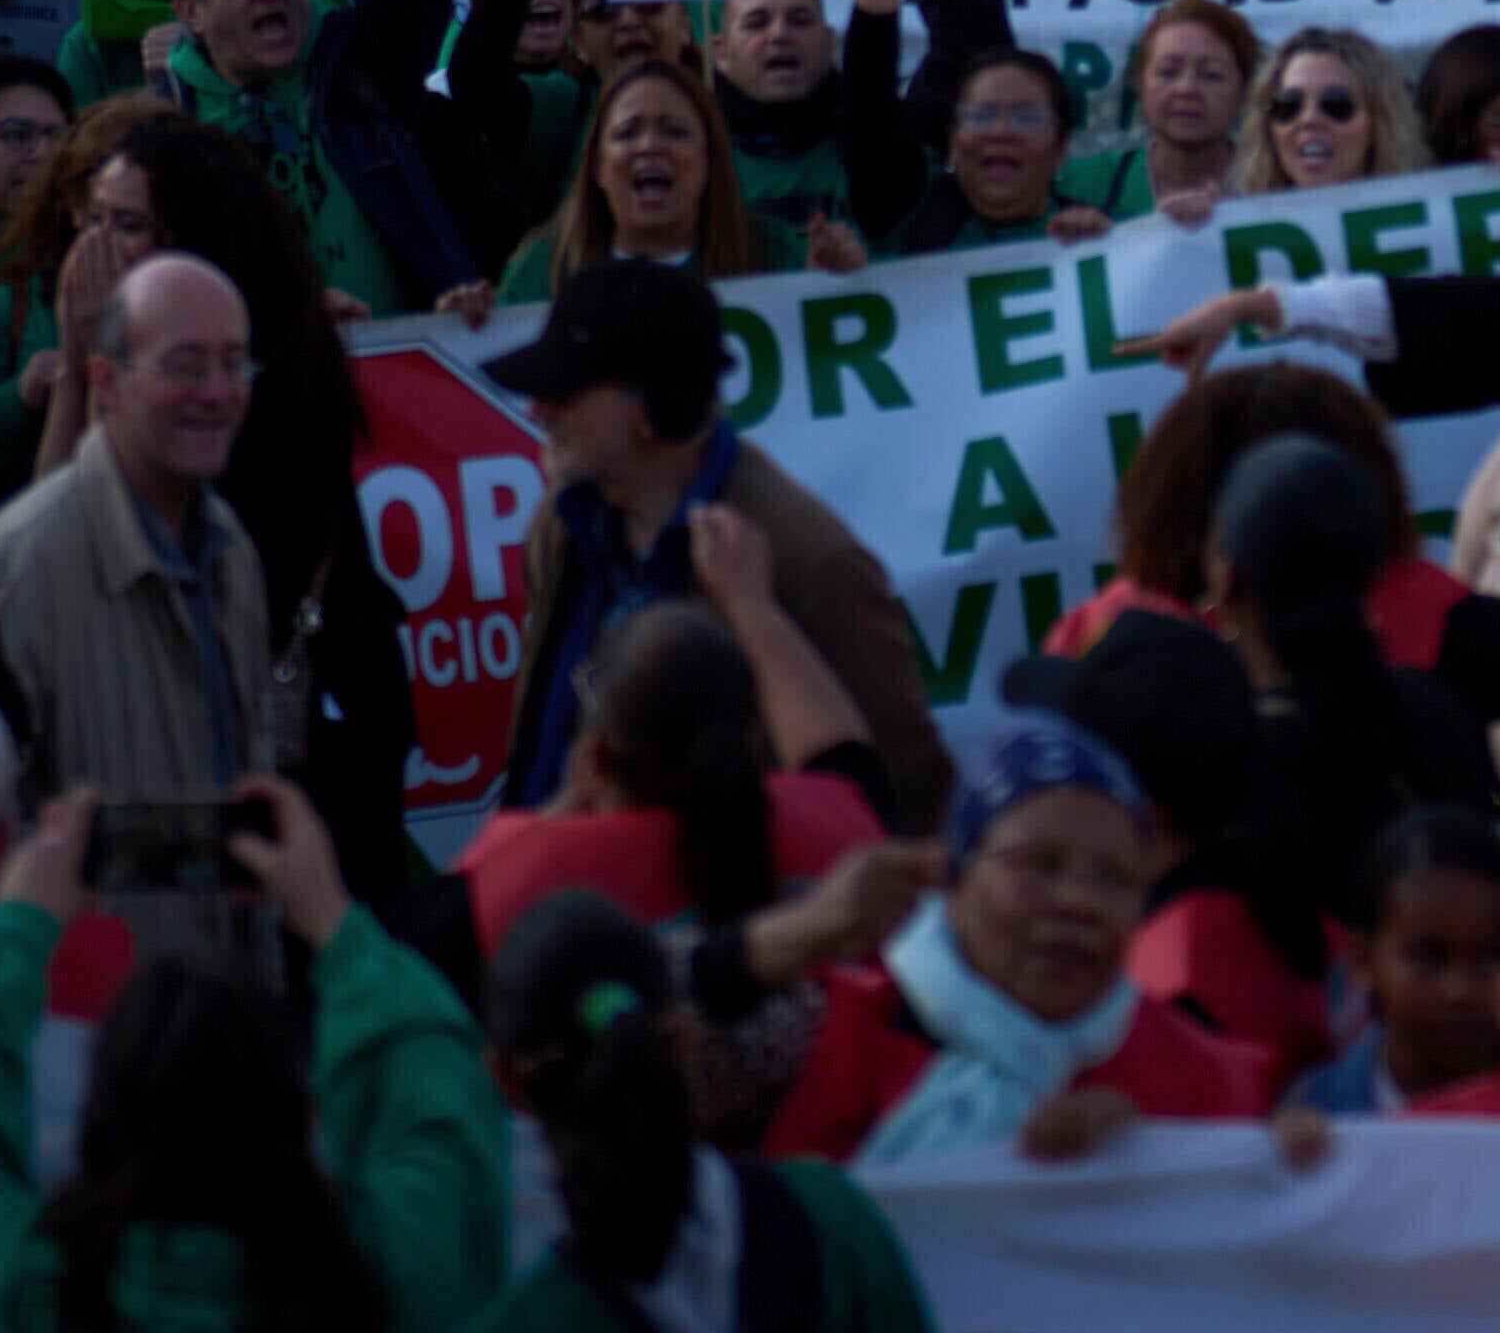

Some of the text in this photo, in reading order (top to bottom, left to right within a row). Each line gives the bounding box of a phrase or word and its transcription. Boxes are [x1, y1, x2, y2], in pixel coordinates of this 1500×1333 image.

[967, 255, 1148, 396] EL
[354, 451, 548, 615] OP
[942, 433, 1058, 558] A
